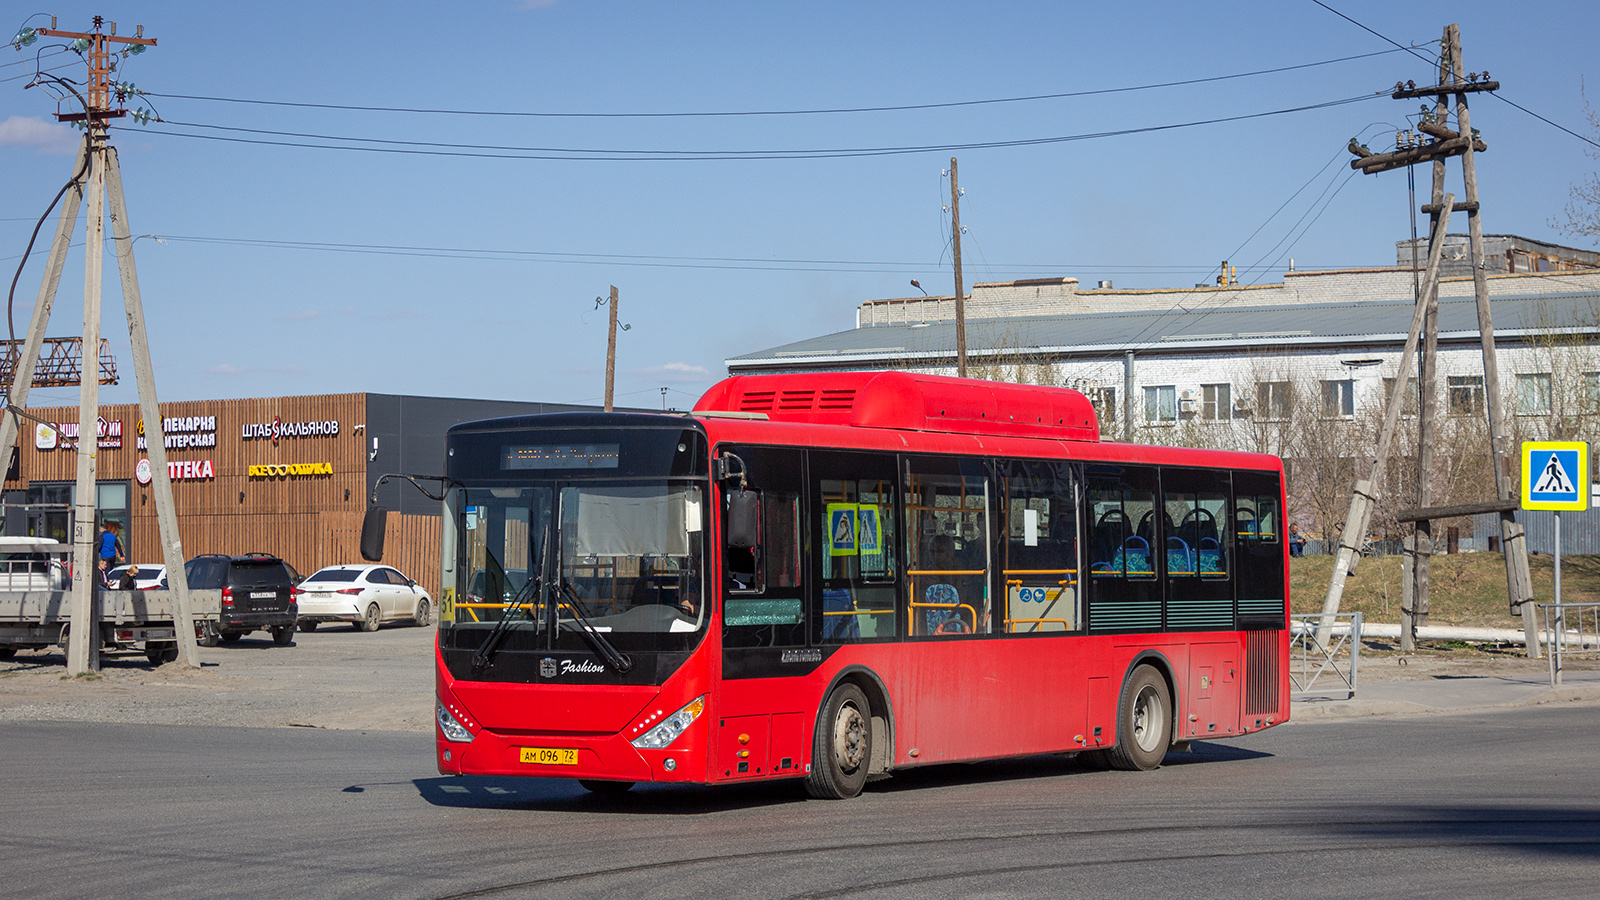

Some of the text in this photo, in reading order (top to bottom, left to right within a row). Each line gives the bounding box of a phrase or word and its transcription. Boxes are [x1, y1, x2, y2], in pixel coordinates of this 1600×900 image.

[164, 416, 215, 432] ПЕКАРНЯ
[242, 421, 338, 437] ШТАБ КАЛЬЯНОВ
[137, 433, 215, 449] КОИТЕРСКАЯ
[167, 460, 214, 478] ПТЕКА
[76, 526, 82, 537] 51
[560, 659, 604, 675] Fashion
[540, 750, 558, 762] 096
[564, 750, 574, 760] 72
